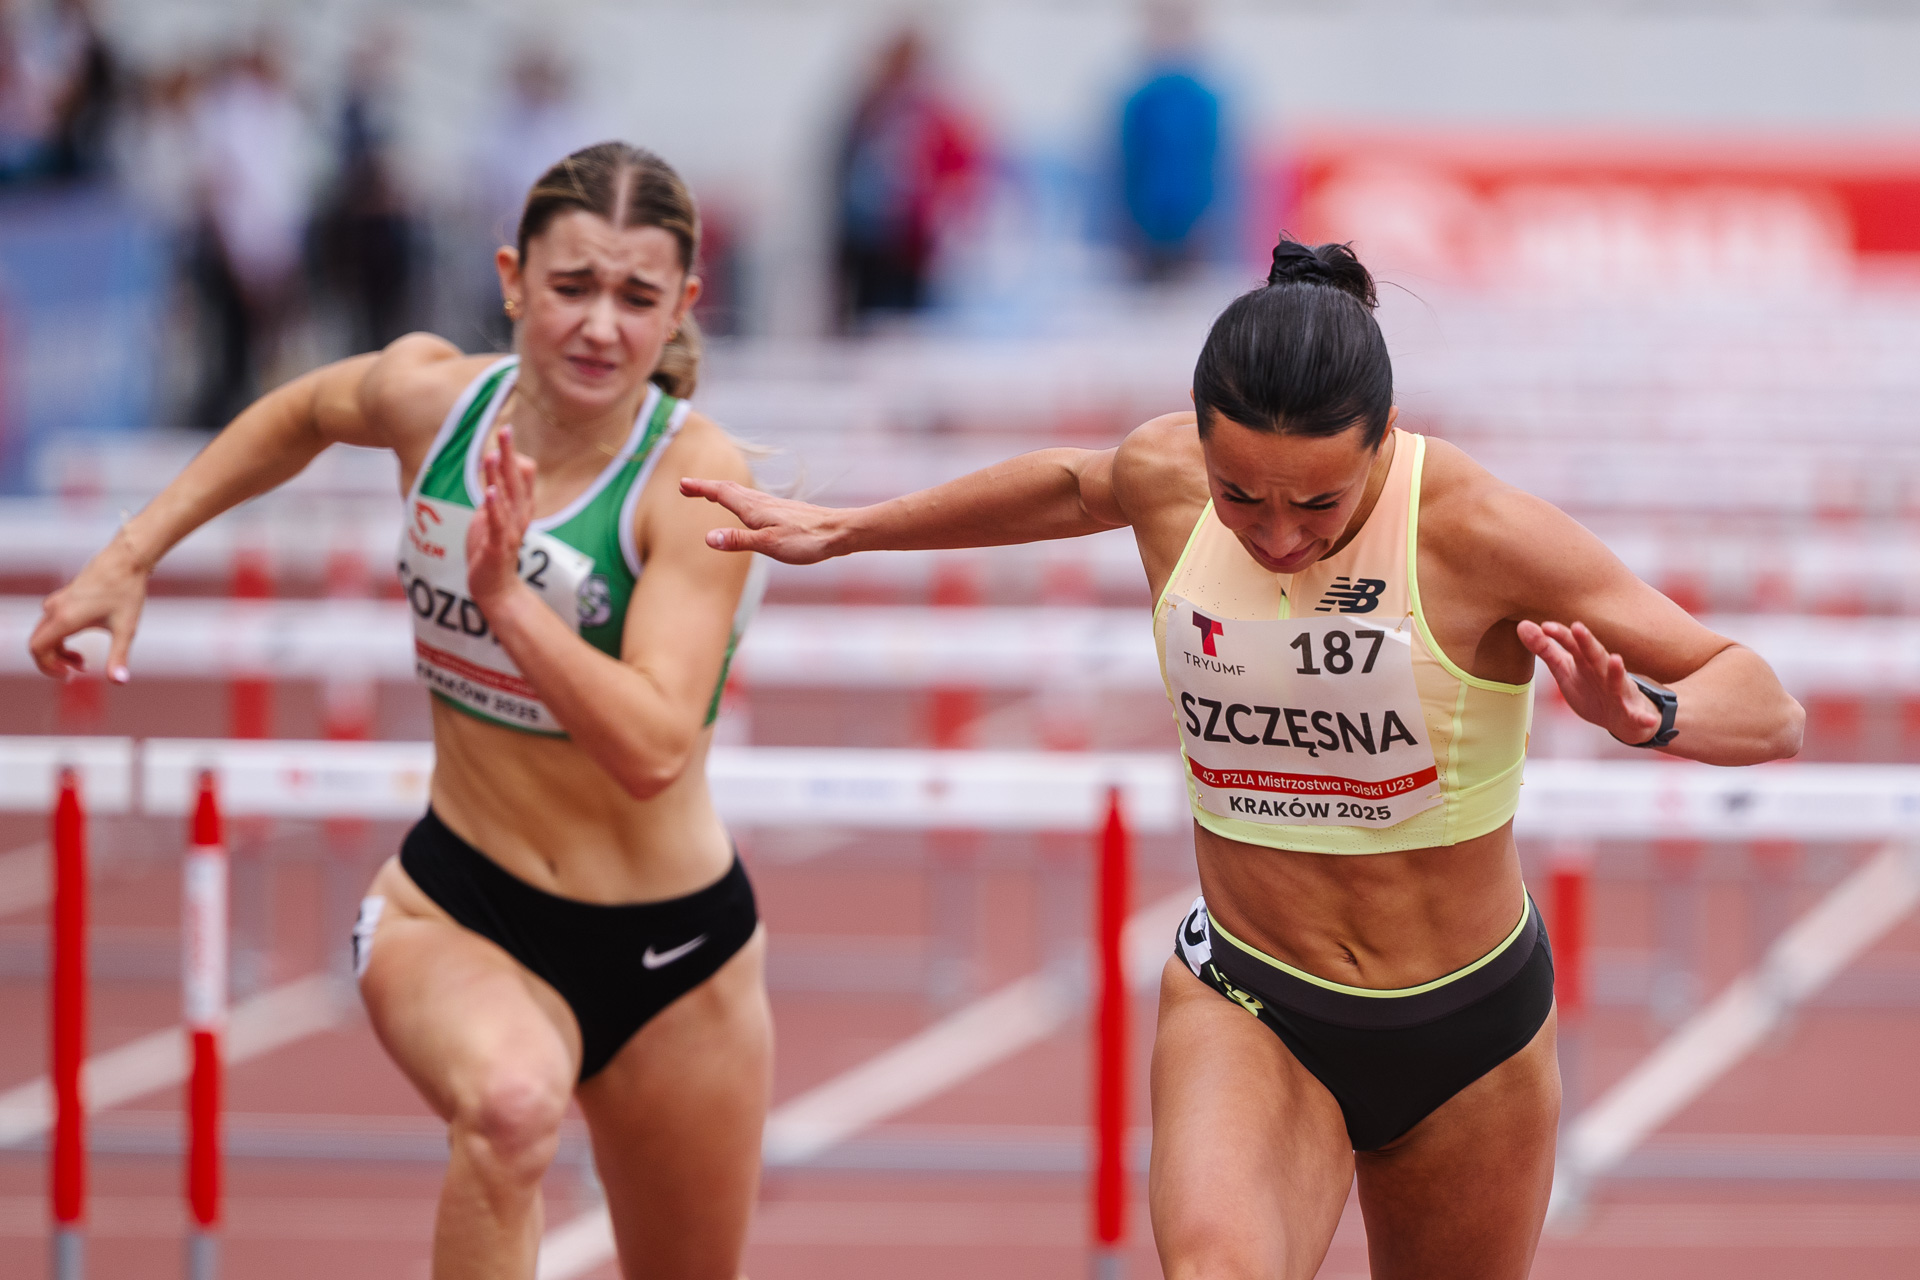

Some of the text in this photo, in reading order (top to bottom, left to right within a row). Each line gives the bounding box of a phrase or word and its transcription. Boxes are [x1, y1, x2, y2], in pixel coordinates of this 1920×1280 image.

[1183, 651, 1246, 676] TRYUMF
[1289, 630, 1386, 676] 187
[494, 695, 540, 722] 2025
[1180, 691, 1419, 758] SZCZĘSNA
[1202, 770, 1416, 796] 42. PZLA Mistrzostwa Polski U23
[1228, 796, 1393, 821] KRAKÓW 2025
